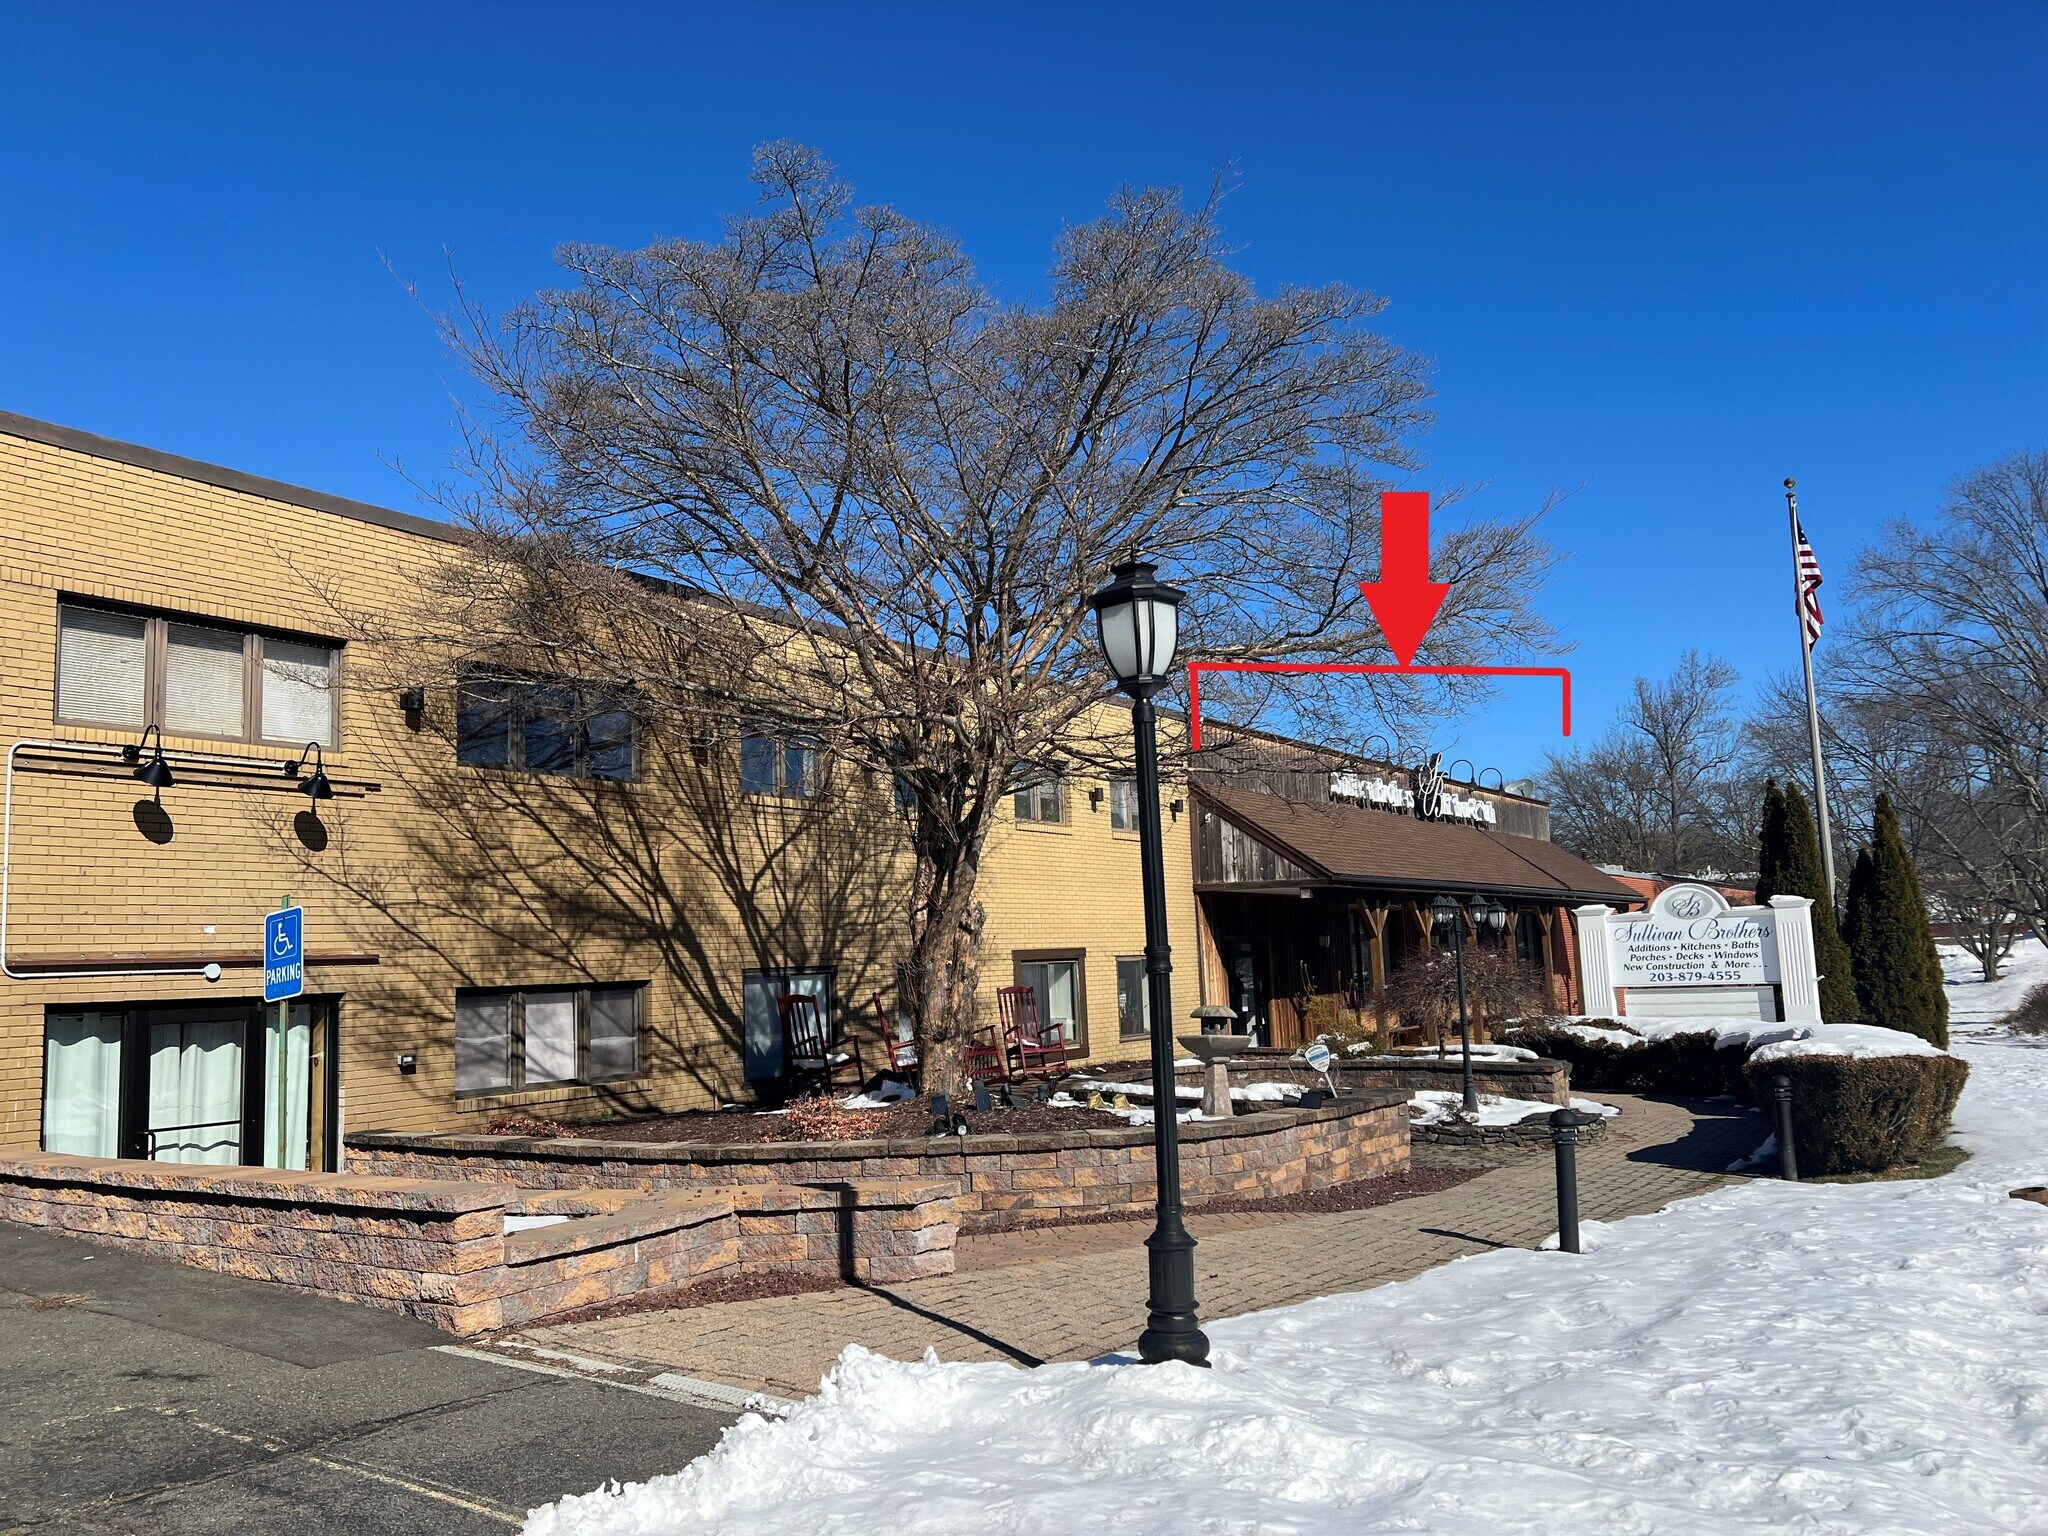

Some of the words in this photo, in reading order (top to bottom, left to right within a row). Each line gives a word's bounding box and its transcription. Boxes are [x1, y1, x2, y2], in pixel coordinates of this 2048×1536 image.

[1614, 920, 1684, 943] Sullivan
[1688, 918, 1774, 941] Brothers
[1627, 944, 1671, 953] Additions
[1680, 942, 1722, 951] Kitchens
[1731, 941, 1760, 949] Baths
[1630, 953, 1666, 962] Porches
[1676, 952, 1704, 960] Decks
[1713, 950, 1759, 959] Windows
[1623, 963, 1643, 971] New
[1646, 961, 1705, 971] Construction
[1711, 961, 1719, 969] &
[266, 962, 301, 987] PARKING
[1649, 970, 1741, 982] 203-879-4555
